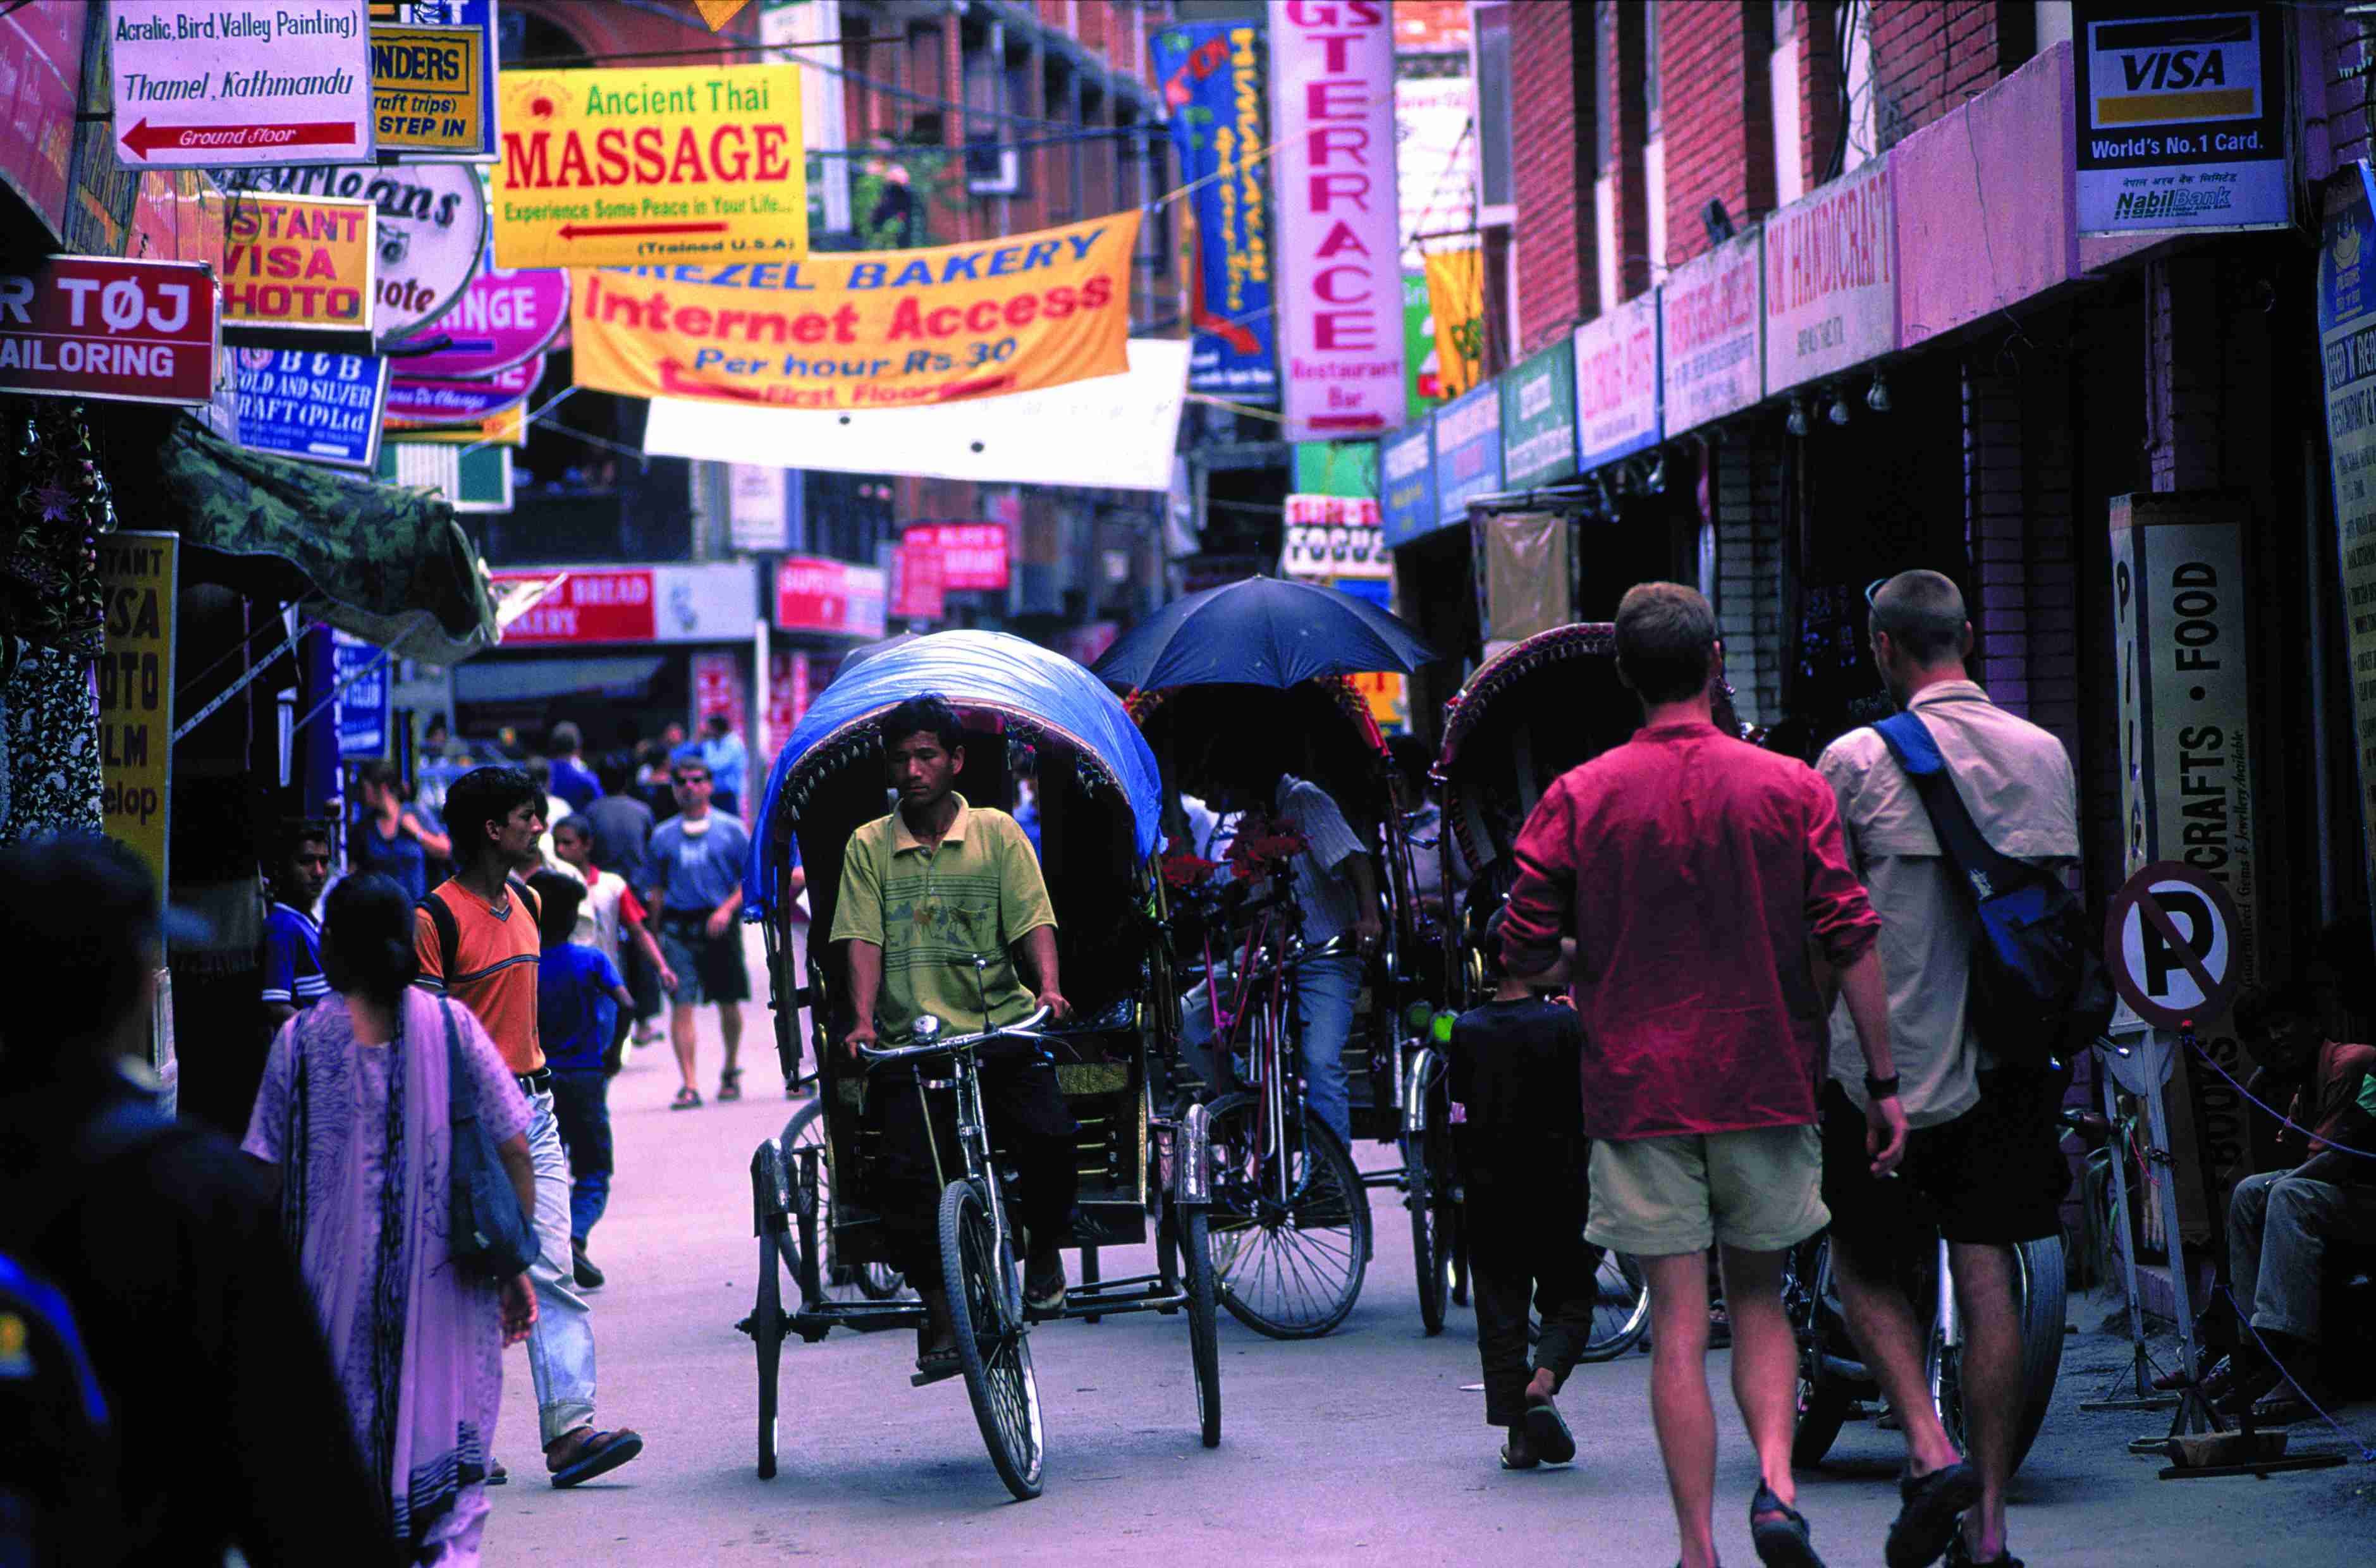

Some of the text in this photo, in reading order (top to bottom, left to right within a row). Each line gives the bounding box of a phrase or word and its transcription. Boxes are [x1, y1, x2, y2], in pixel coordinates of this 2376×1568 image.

[277, 9, 357, 40] Painting)
[220, 67, 353, 99] Kathmandu
[2120, 49, 2226, 91] VISA
[412, 95, 456, 115] trips)
[586, 83, 696, 116] Ancient
[706, 79, 769, 113] Thai
[179, 126, 297, 147] Ground floor
[379, 116, 466, 137] STEP IN
[501, 123, 790, 190] MASSAGE
[2091, 137, 2160, 160] World's
[2215, 131, 2264, 152] Card.
[1305, 33, 1376, 352] TERRACE
[505, 200, 591, 224] Experience
[594, 197, 637, 219] Some
[641, 197, 689, 218] Peace
[693, 197, 708, 215] in
[712, 196, 746, 215] Your
[638, 240, 723, 257] (Trained
[1791, 171, 1891, 309] HANDICRAFT
[223, 245, 338, 281] VISA
[847, 227, 1108, 291] BAKERY
[56, 275, 190, 334] TØJ
[584, 274, 1113, 345] Internet Access
[0, 338, 175, 379] AILORING
[281, 349, 302, 373] B
[339, 353, 364, 381] B
[694, 347, 769, 377] Per
[783, 348, 886, 378] hour
[1290, 358, 1399, 381] Restaurant
[279, 374, 309, 398] AND
[311, 379, 373, 409] SILVER
[1326, 386, 1363, 408] Bar
[570, 576, 649, 606] BREAD
[2172, 561, 2220, 671] FOOD
